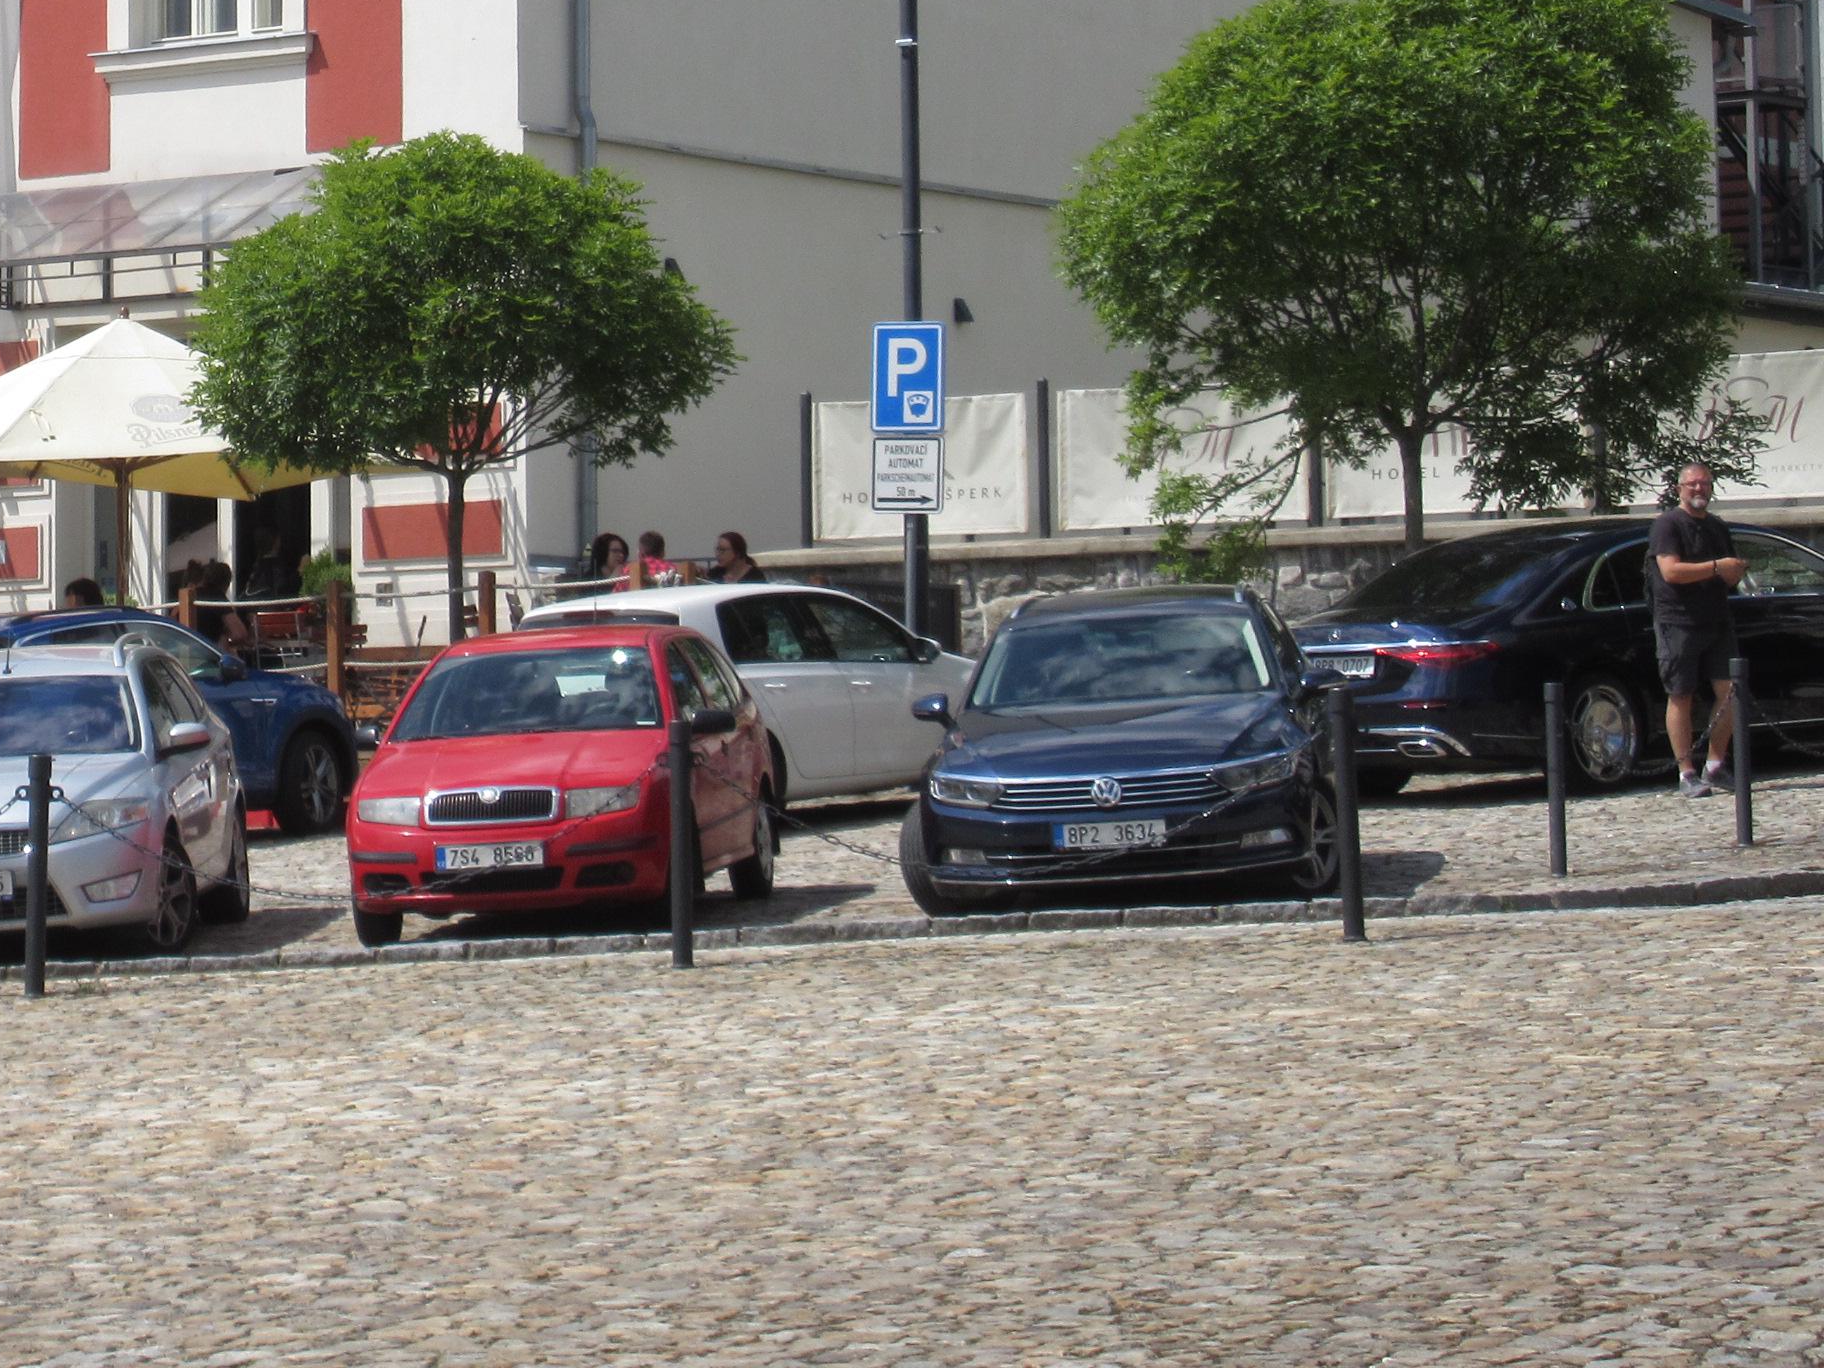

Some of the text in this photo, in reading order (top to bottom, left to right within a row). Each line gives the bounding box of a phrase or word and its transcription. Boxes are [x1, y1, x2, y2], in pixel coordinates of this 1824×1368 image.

[887, 338, 927, 397] P
[127, 422, 201, 449] Pilsne
[884, 443, 928, 455] PARKOVACÍ
[888, 458, 924, 469] AUTOMAT
[1371, 466, 1440, 480] HOEL
[945, 487, 1002, 500] ŠPERK
[1068, 823, 1156, 844] 8P2 3634
[449, 848, 480, 866] 7S4
